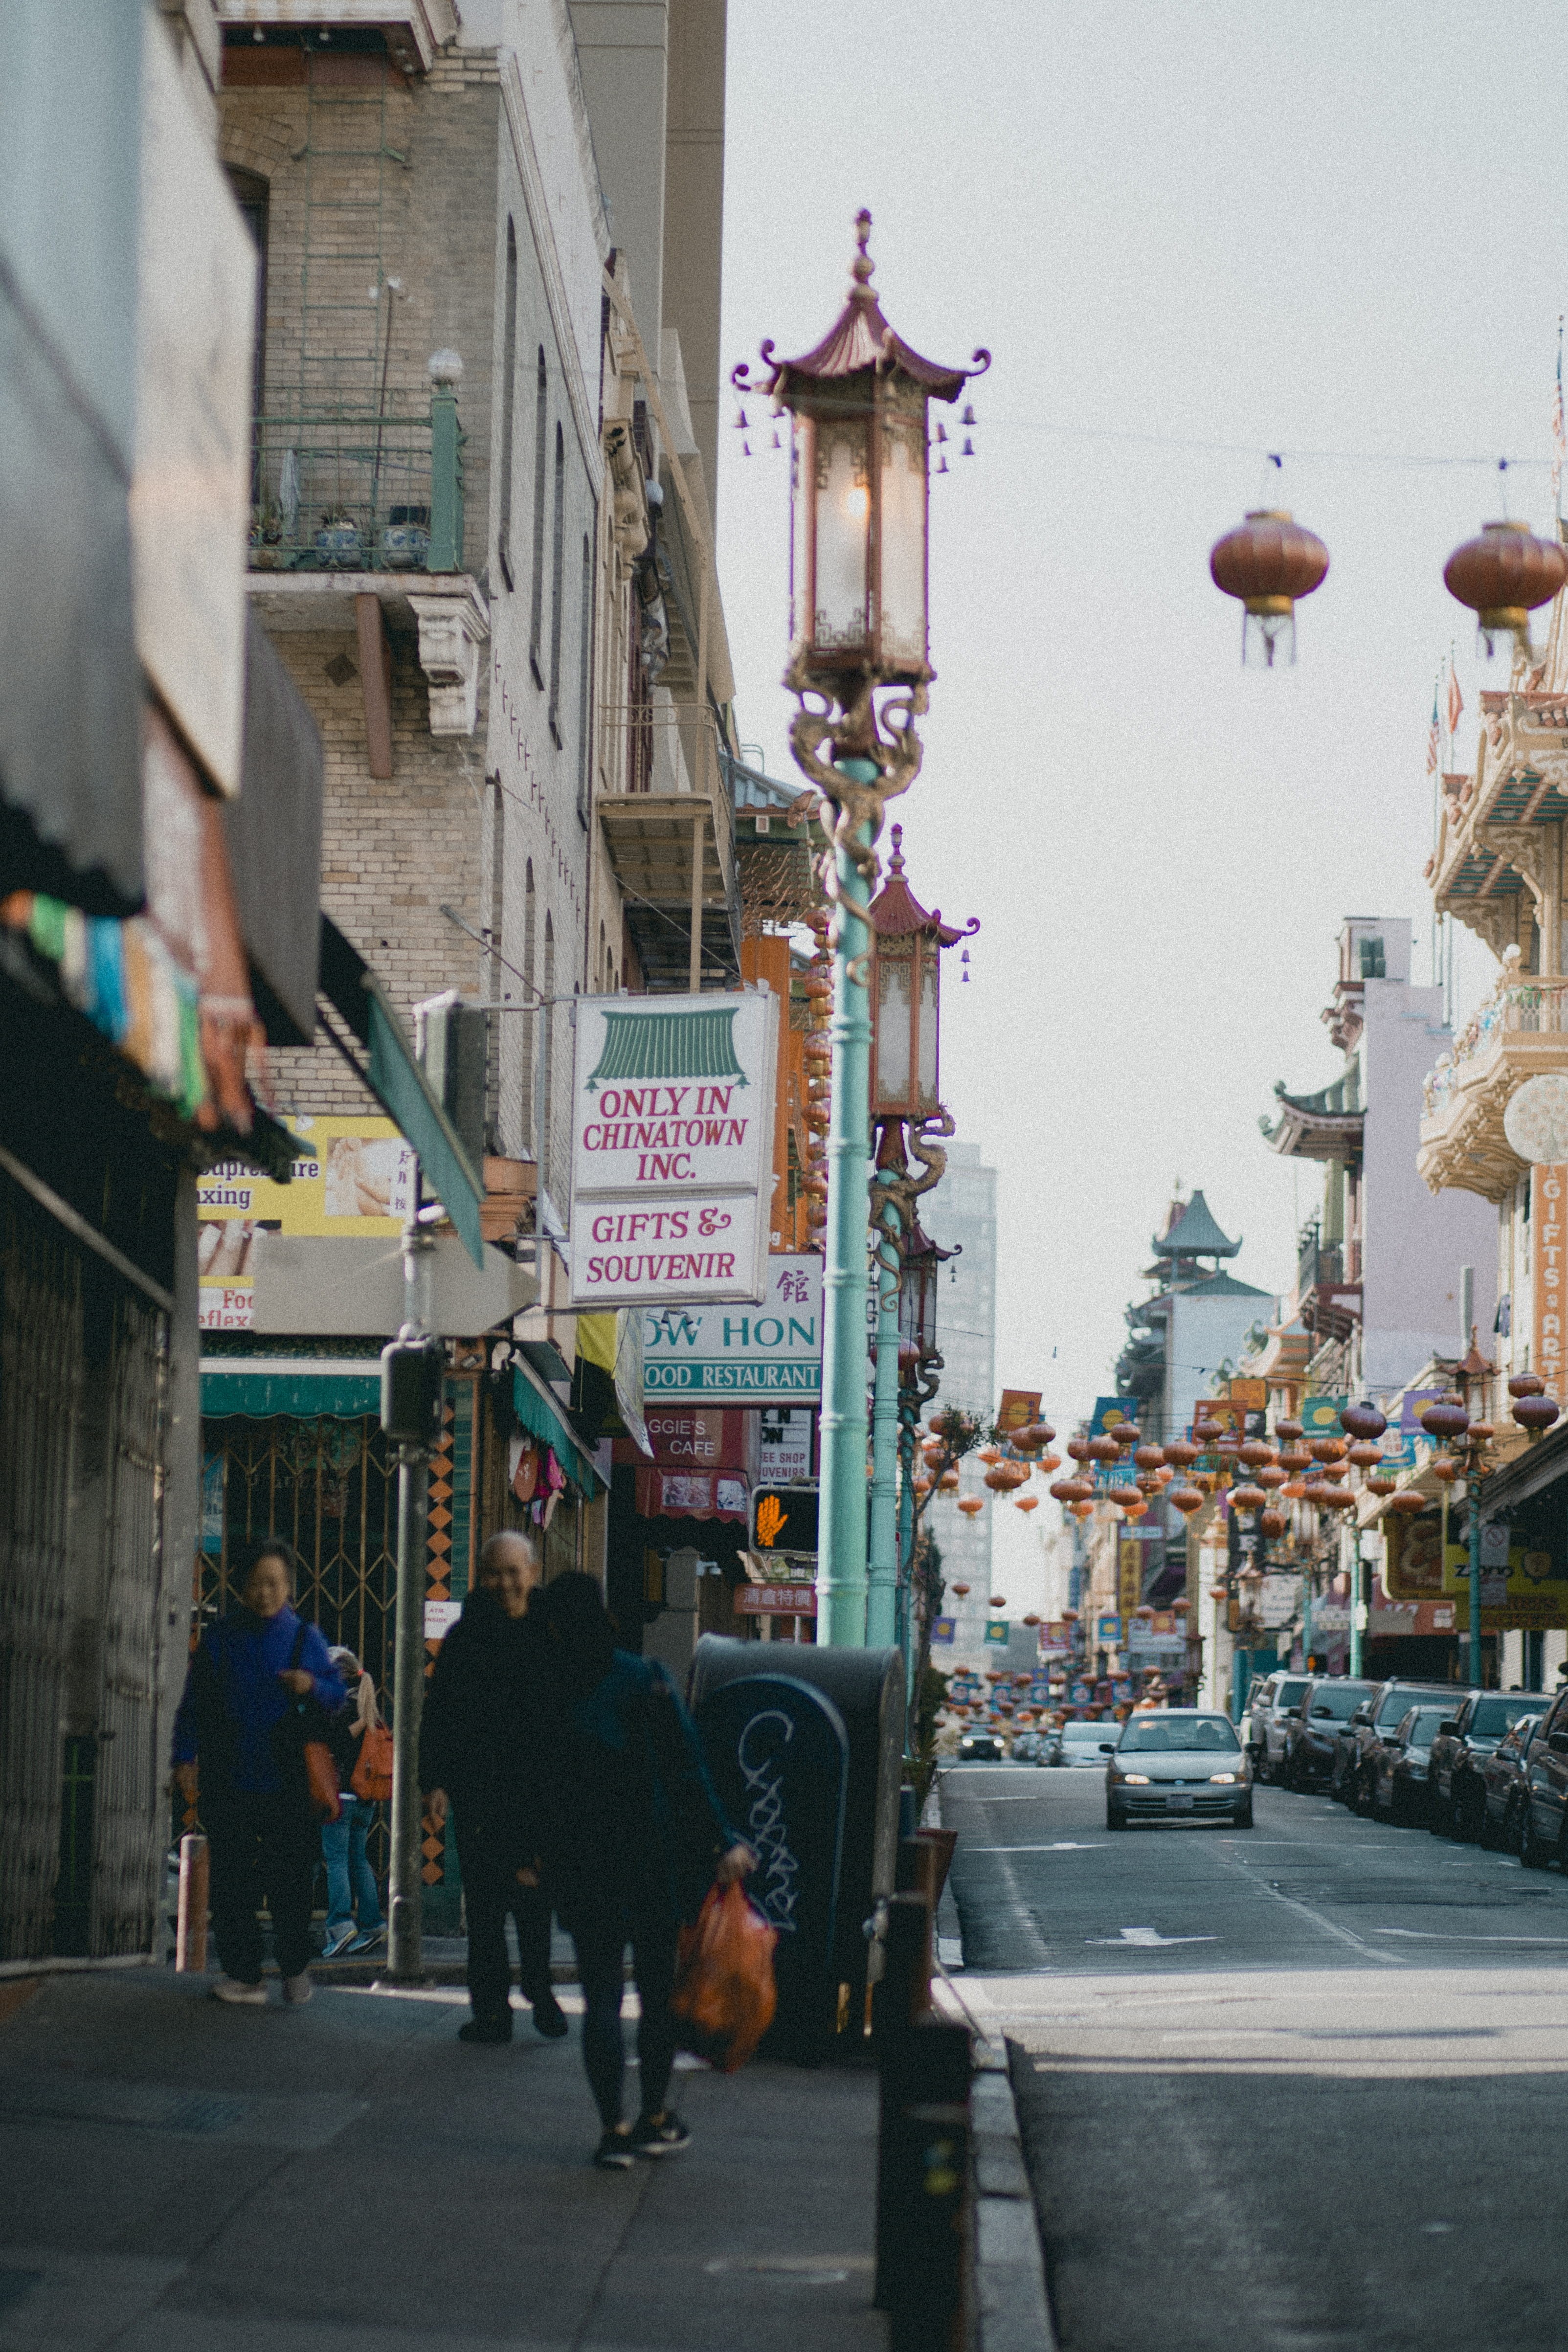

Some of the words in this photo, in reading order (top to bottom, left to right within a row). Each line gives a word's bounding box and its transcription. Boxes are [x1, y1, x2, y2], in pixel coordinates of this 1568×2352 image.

[600, 1087, 689, 1118] ONLY
[695, 1085, 735, 1114] IN
[583, 1119, 748, 1151] CHINATOWN
[636, 1153, 696, 1181] INC.
[592, 1211, 689, 1242] GIFTS
[698, 1207, 732, 1236] &
[1543, 1179, 1561, 1288] GIFTS
[587, 1253, 736, 1282] SOUVENIR
[722, 1316, 815, 1347] HON
[702, 1366, 818, 1387] RESTAURANT
[670, 1440, 715, 1456] CAFE
[761, 1452, 775, 1463] EE
[780, 1453, 805, 1464] SHOP
